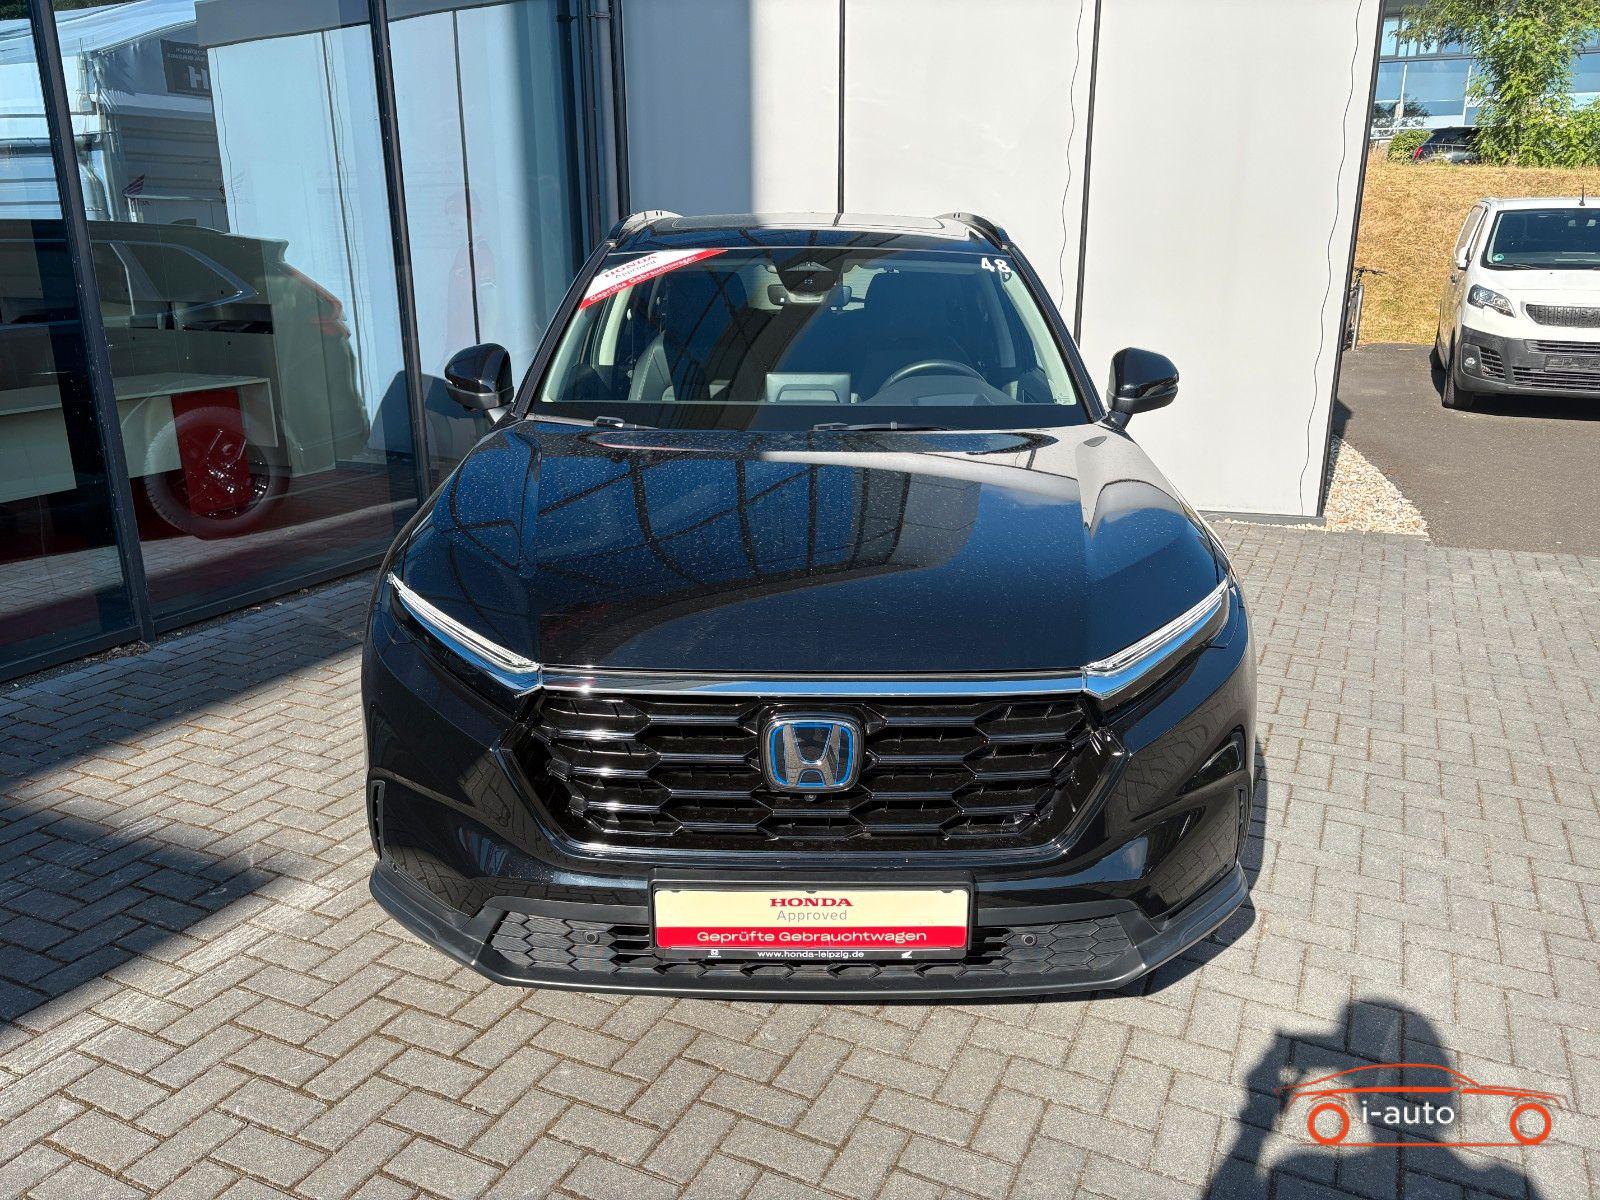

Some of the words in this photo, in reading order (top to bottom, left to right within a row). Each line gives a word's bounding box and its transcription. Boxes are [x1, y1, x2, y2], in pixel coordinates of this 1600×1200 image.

[981, 257, 1012, 273] 48
[769, 897, 854, 907] HONDA
[776, 910, 848, 923] Approved
[696, 931, 775, 944] Geprüfte
[778, 931, 927, 945] Gebrauchtwagen
[757, 949, 865, 960] www.honda-leipzig.de
